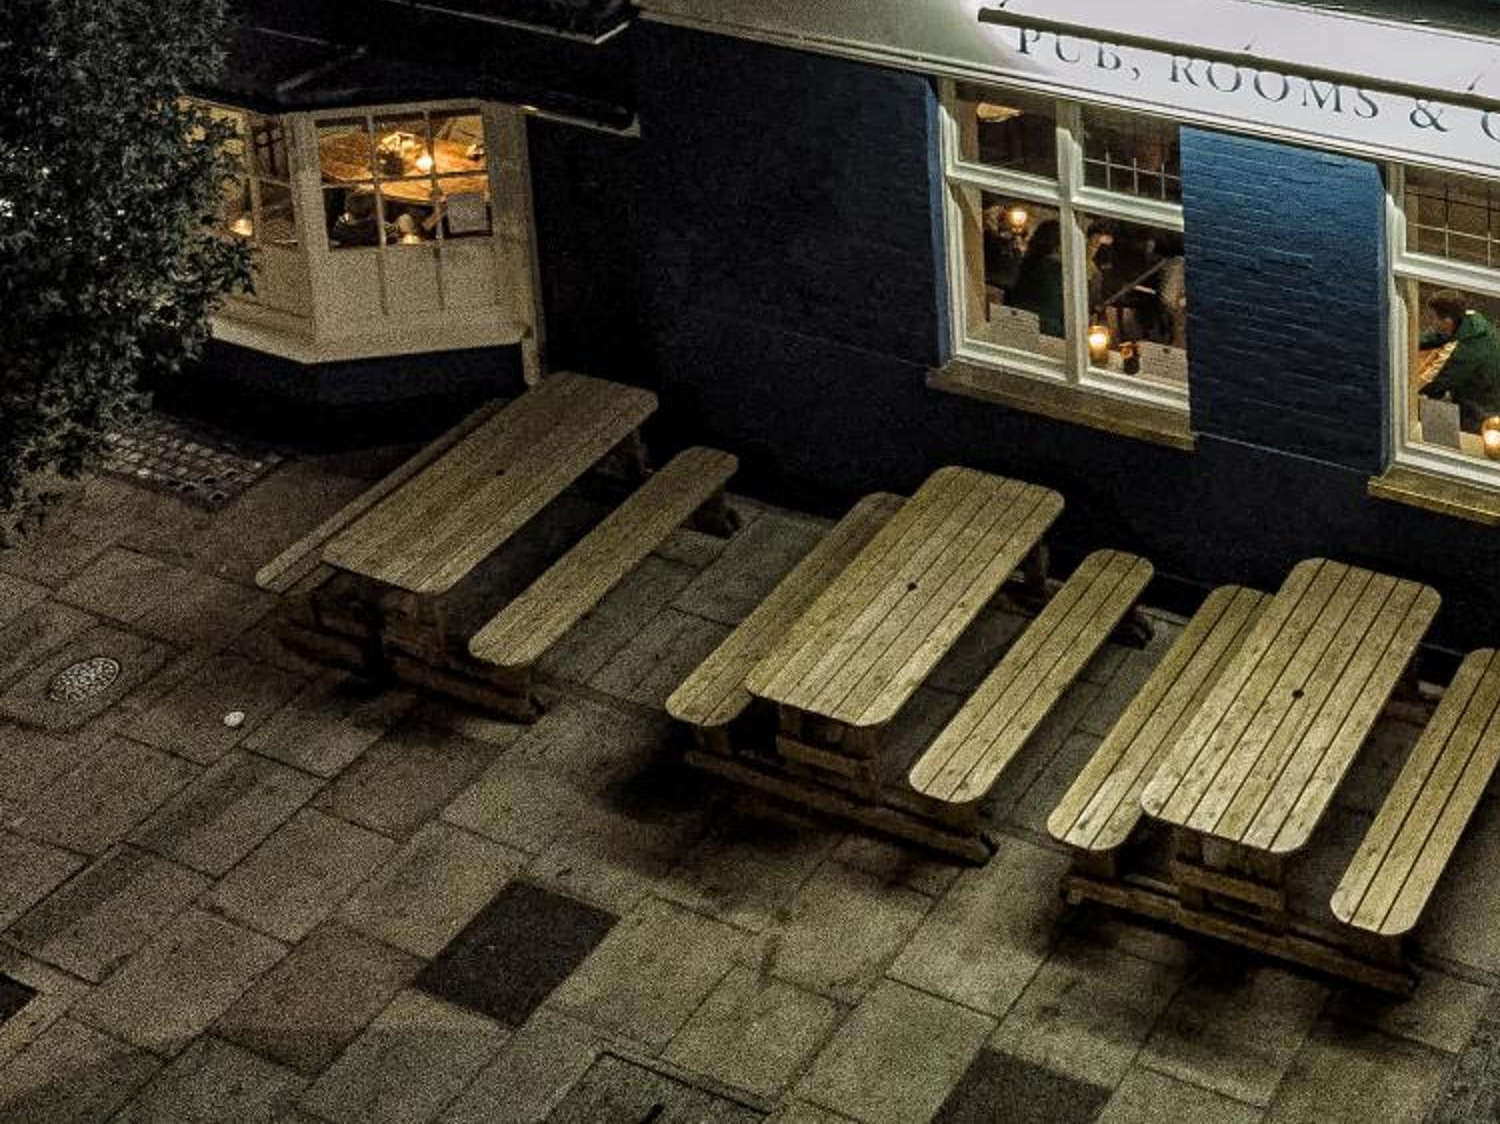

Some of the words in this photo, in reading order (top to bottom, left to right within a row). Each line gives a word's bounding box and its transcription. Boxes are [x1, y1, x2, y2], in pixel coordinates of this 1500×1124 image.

[1016, 27, 1140, 80] PUB,
[1168, 54, 1379, 119] ROOMS
[1409, 99, 1448, 133] &
